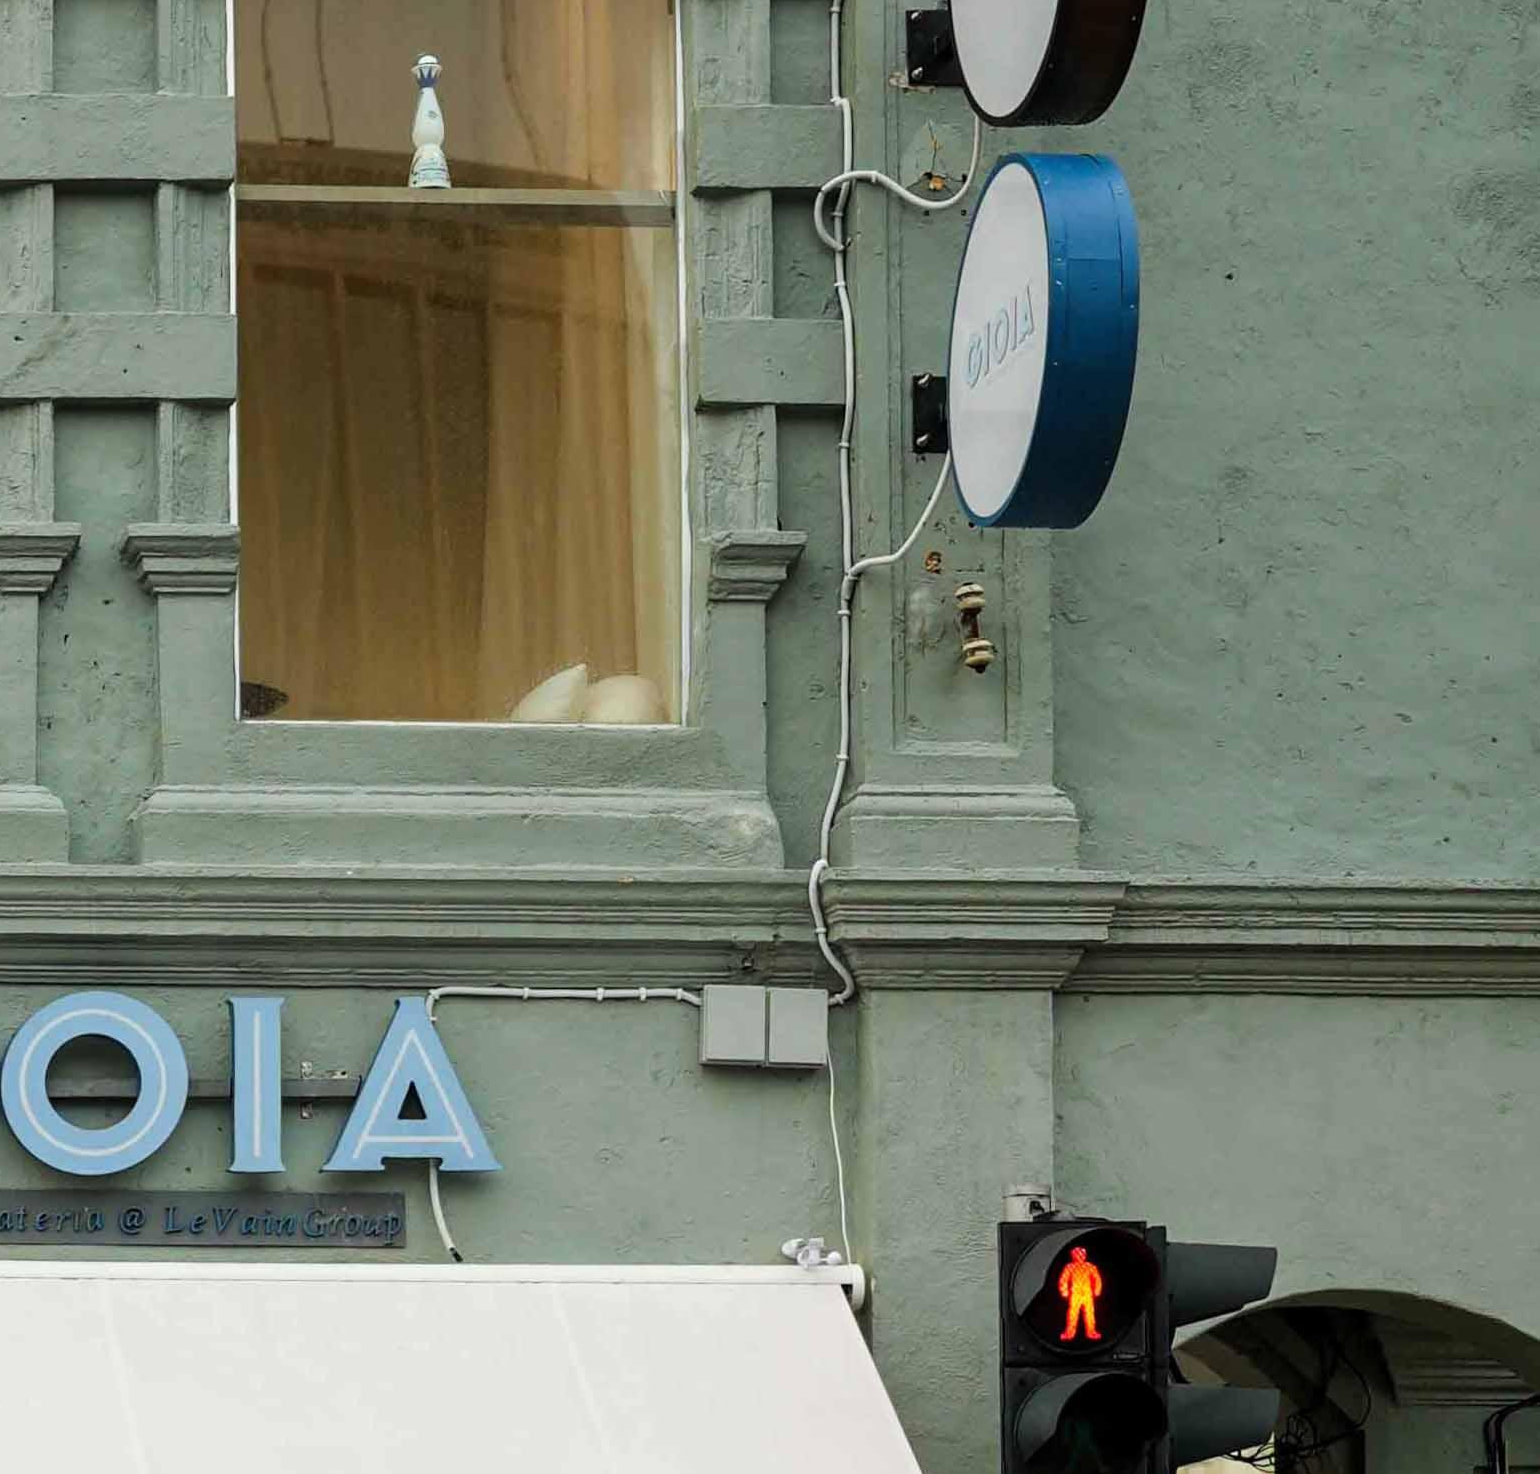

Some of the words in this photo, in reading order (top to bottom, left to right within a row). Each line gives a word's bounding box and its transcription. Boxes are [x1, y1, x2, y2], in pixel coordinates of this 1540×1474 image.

[964, 284, 1035, 389] GIOIA
[119, 1207, 147, 1236] @
[303, 1208, 403, 1247] Group
